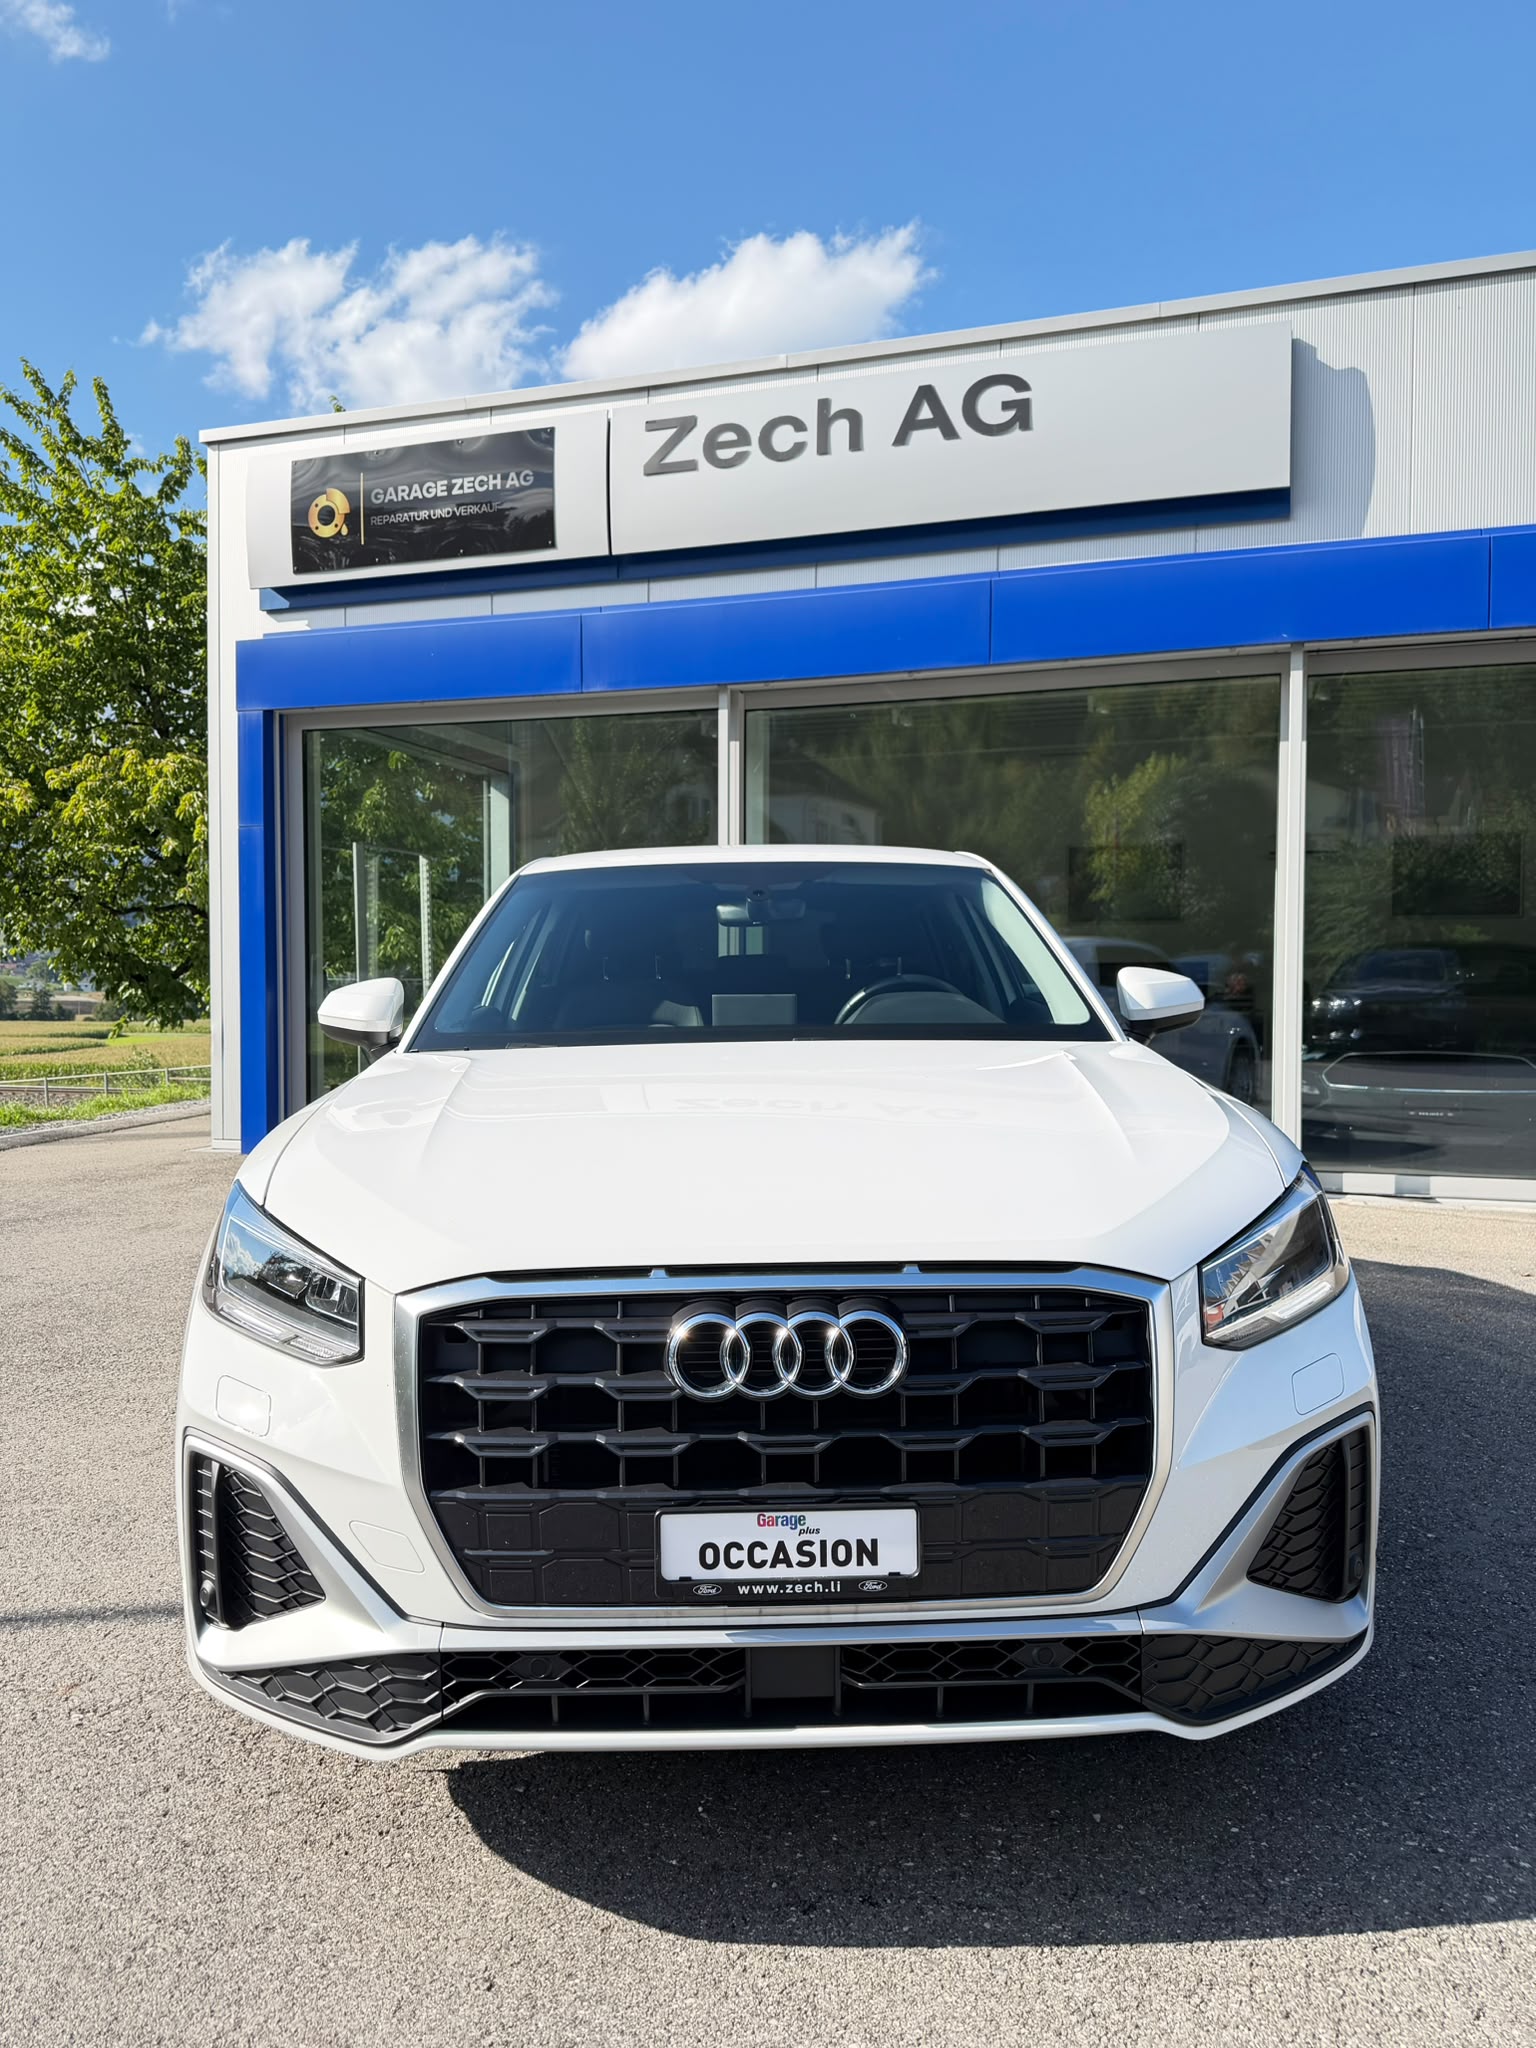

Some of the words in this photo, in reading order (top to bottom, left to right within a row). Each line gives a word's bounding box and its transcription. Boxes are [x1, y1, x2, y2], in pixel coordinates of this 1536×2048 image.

[643, 397, 865, 477] Zech
[892, 374, 1034, 447] AG
[370, 480, 448, 504] GARAGE
[451, 473, 501, 495] ZECH
[505, 469, 534, 489] AG
[370, 510, 429, 526] REPARATUR
[430, 507, 453, 520] UND
[454, 501, 500, 517] VERKAUF
[757, 1513, 806, 1530] Garage
[798, 1526, 821, 1536] plus
[698, 1538, 879, 1570] OCCASION
[697, 1583, 718, 1595] Ford
[737, 1581, 841, 1595] www.zech.li
